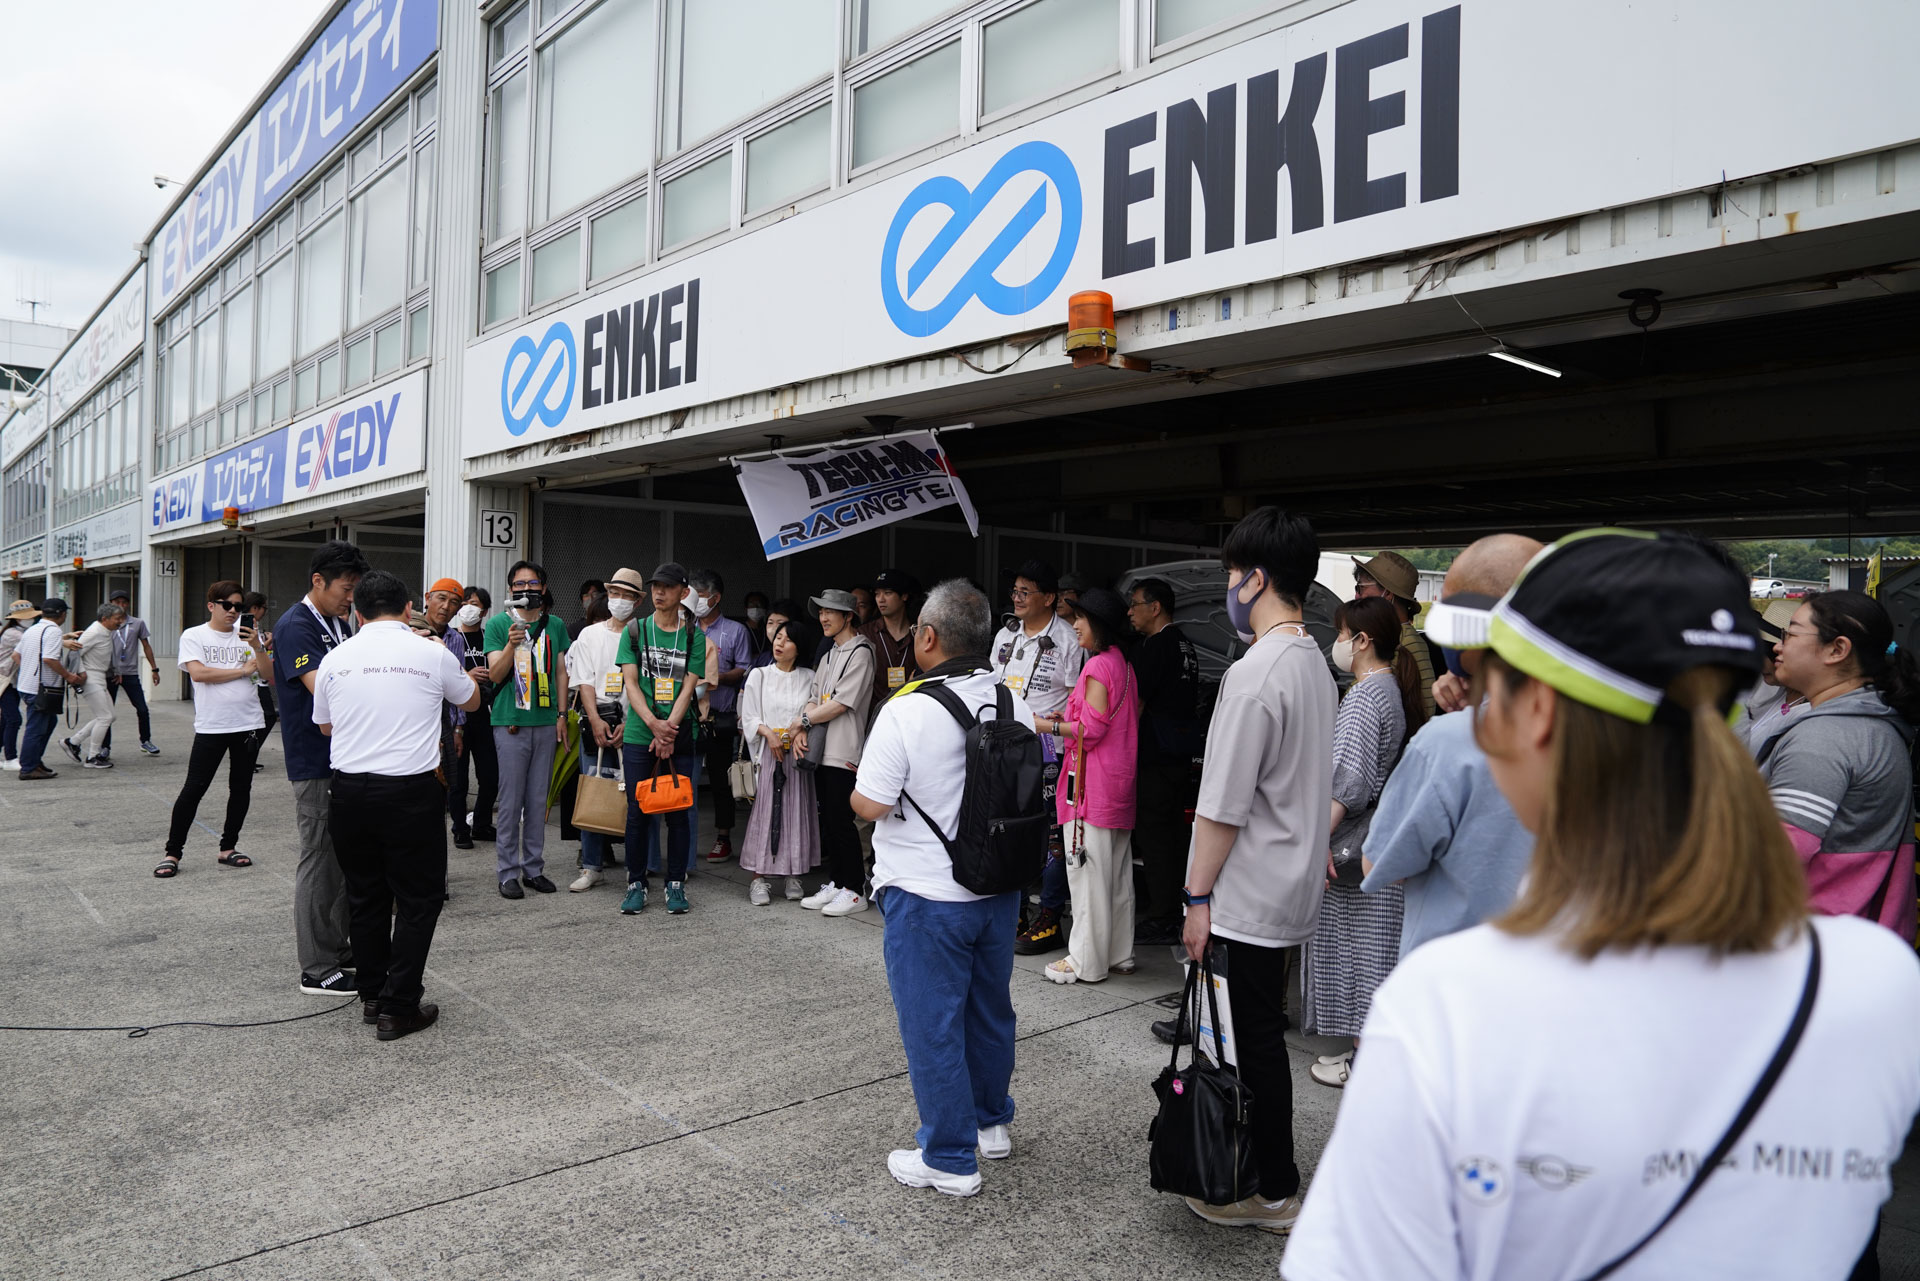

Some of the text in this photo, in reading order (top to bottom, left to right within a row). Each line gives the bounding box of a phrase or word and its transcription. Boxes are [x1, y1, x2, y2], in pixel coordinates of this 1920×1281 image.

[264, 0, 404, 195] エクセディ
[1102, 4, 1461, 280] ENKEI
[162, 134, 251, 297] EXEDY
[582, 278, 700, 410] ENKEI
[295, 392, 401, 493] EXEDY
[153, 472, 198, 529] EXEDY
[212, 445, 273, 511] エクセディ
[485, 515, 513, 545] 13
[779, 483, 956, 547] RACING TE
[160, 561, 176, 575] 14
[295, 654, 309, 669] 25
[408, 667, 431, 679] Racing
[320, 971, 344, 989] PUMA
[1754, 1143, 1832, 1181] MINI
